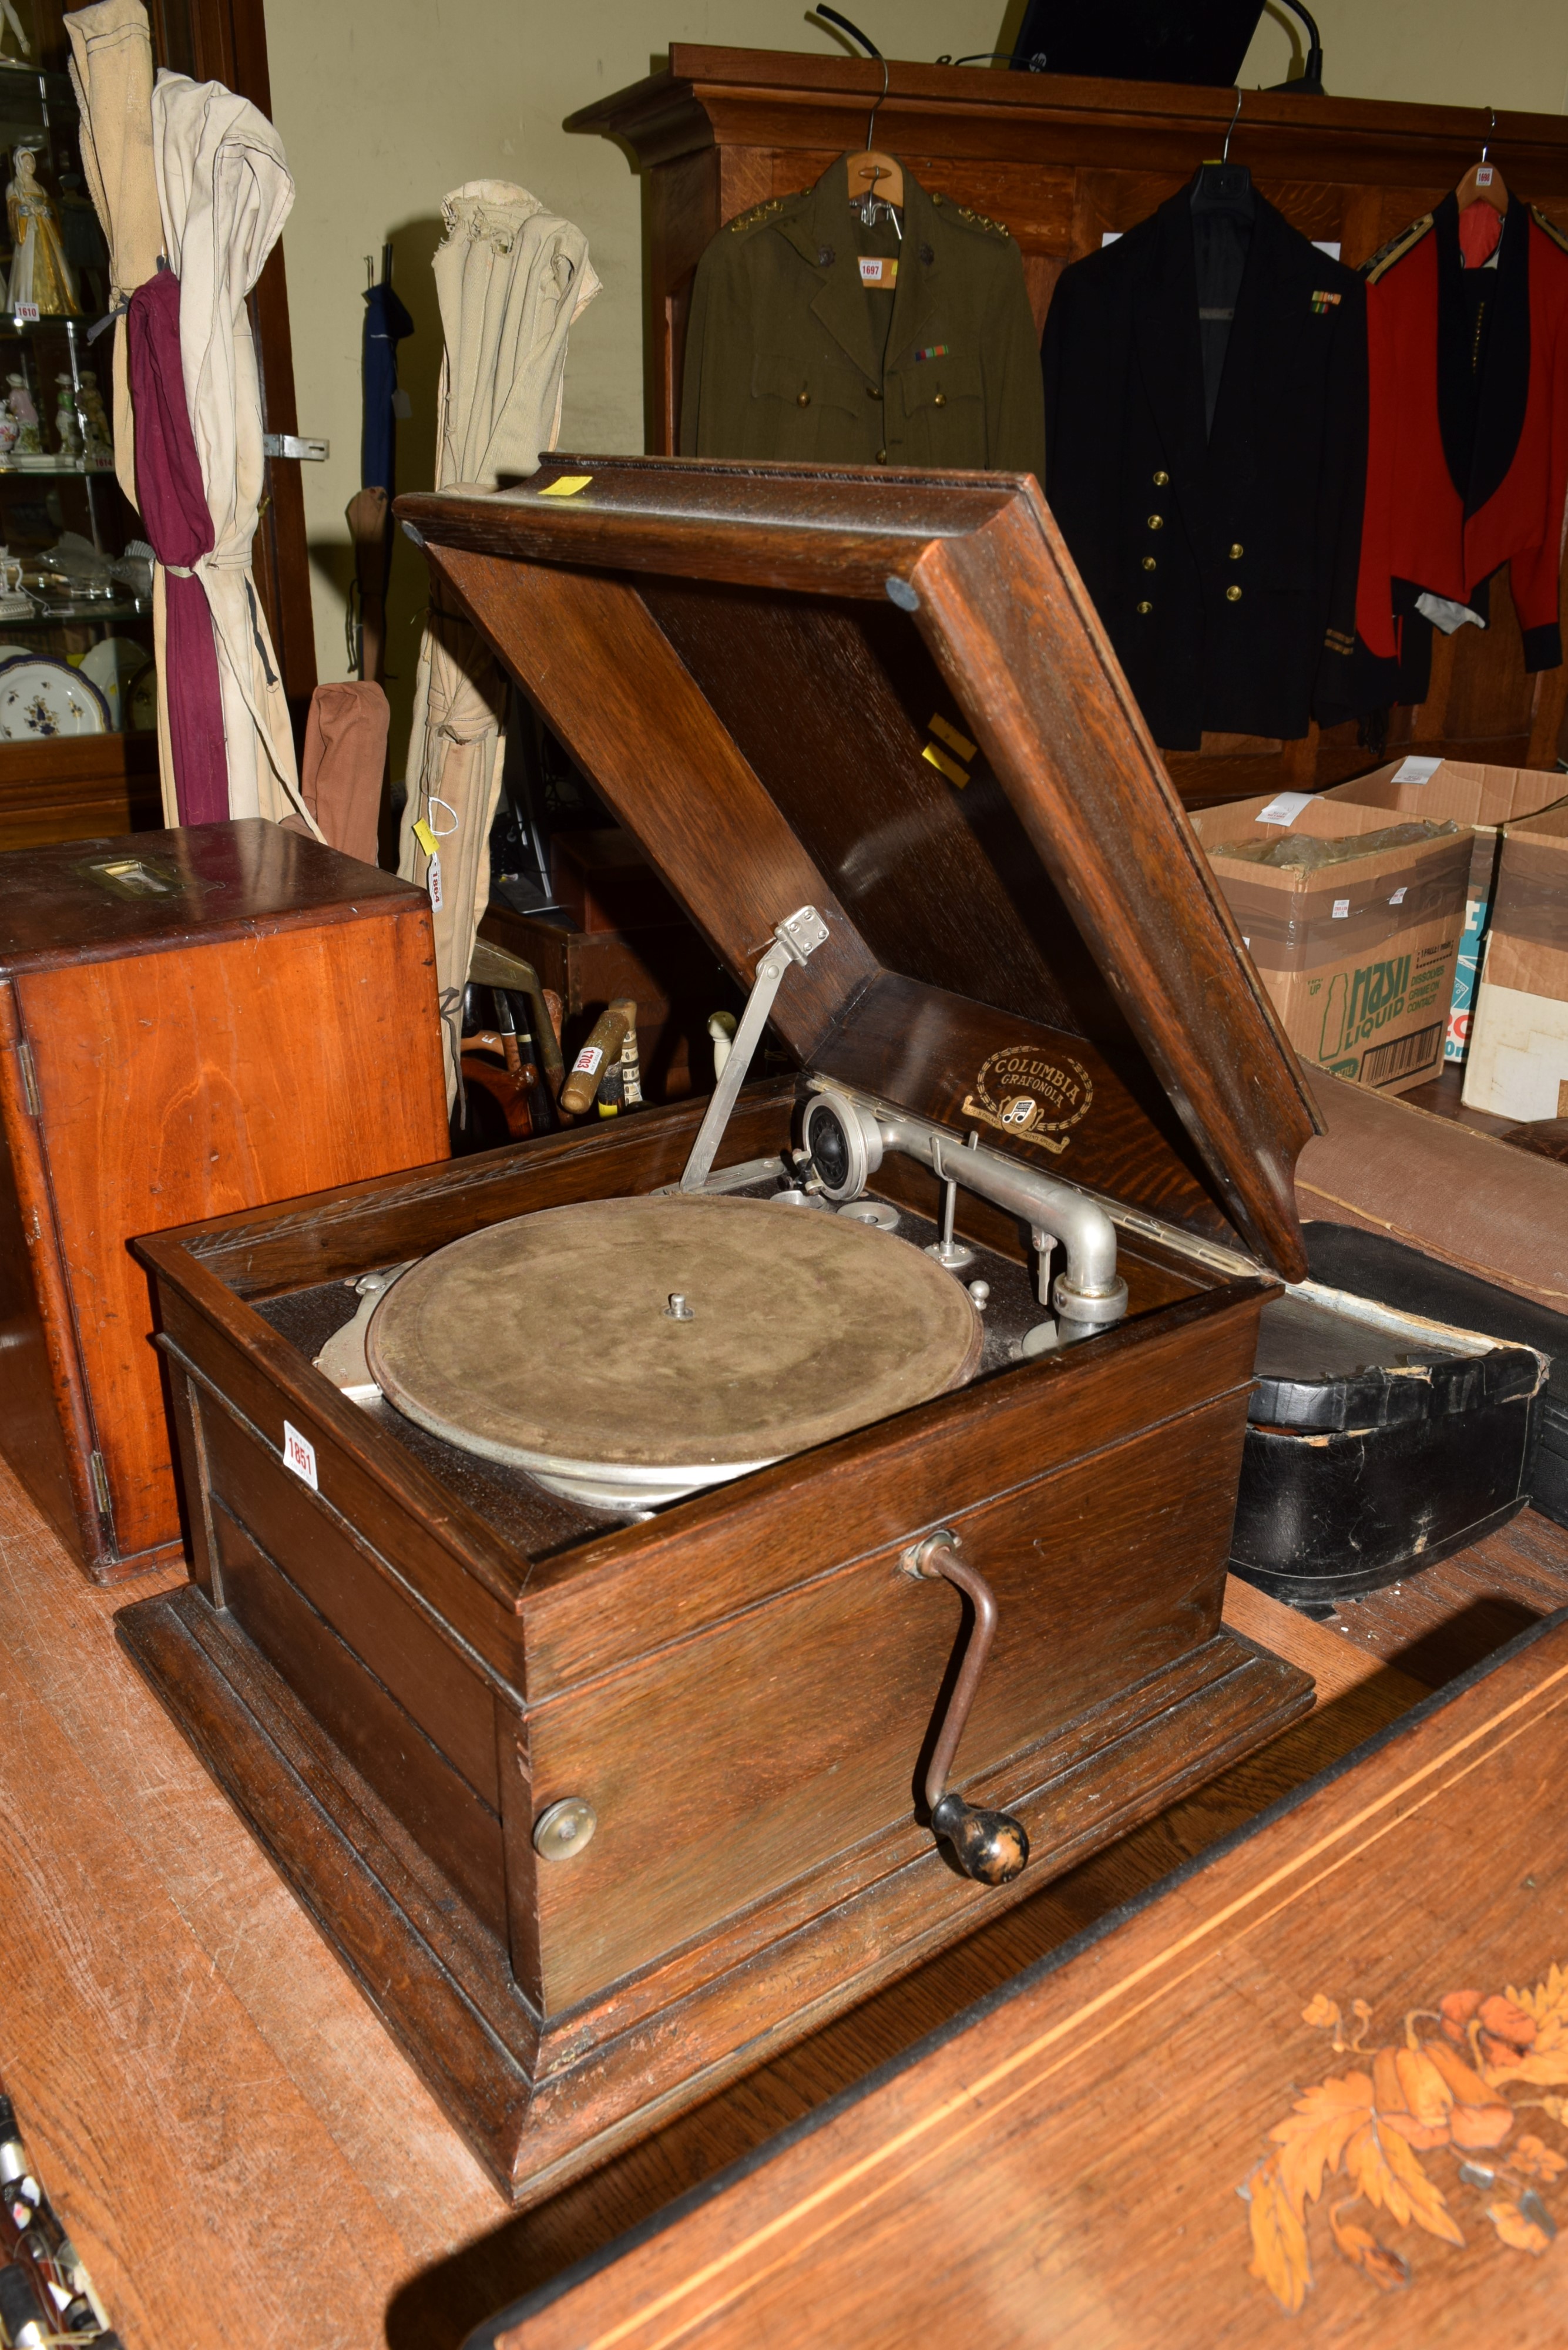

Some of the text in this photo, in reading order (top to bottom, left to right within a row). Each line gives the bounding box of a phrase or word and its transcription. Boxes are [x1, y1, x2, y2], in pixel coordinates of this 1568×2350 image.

[862, 265, 879, 275] 1697
[18, 307, 36, 317] 1610
[1411, 965, 1445, 986] DISSOLVES
[1310, 983, 1321, 996] UP
[1409, 979, 1440, 1001] GRIME ON
[1407, 994, 1437, 1013] CONTACT
[1344, 996, 1405, 1051] LIQUID
[577, 1049, 595, 1068] 1703
[995, 1058, 1080, 1104] COLUMBIA
[1001, 1074, 1065, 1108] GRAFONOLA
[1023, 1132, 1038, 1142] PATENTS
[1039, 1137, 1055, 1149] APPLIED
[289, 1437, 311, 1475] 1851
